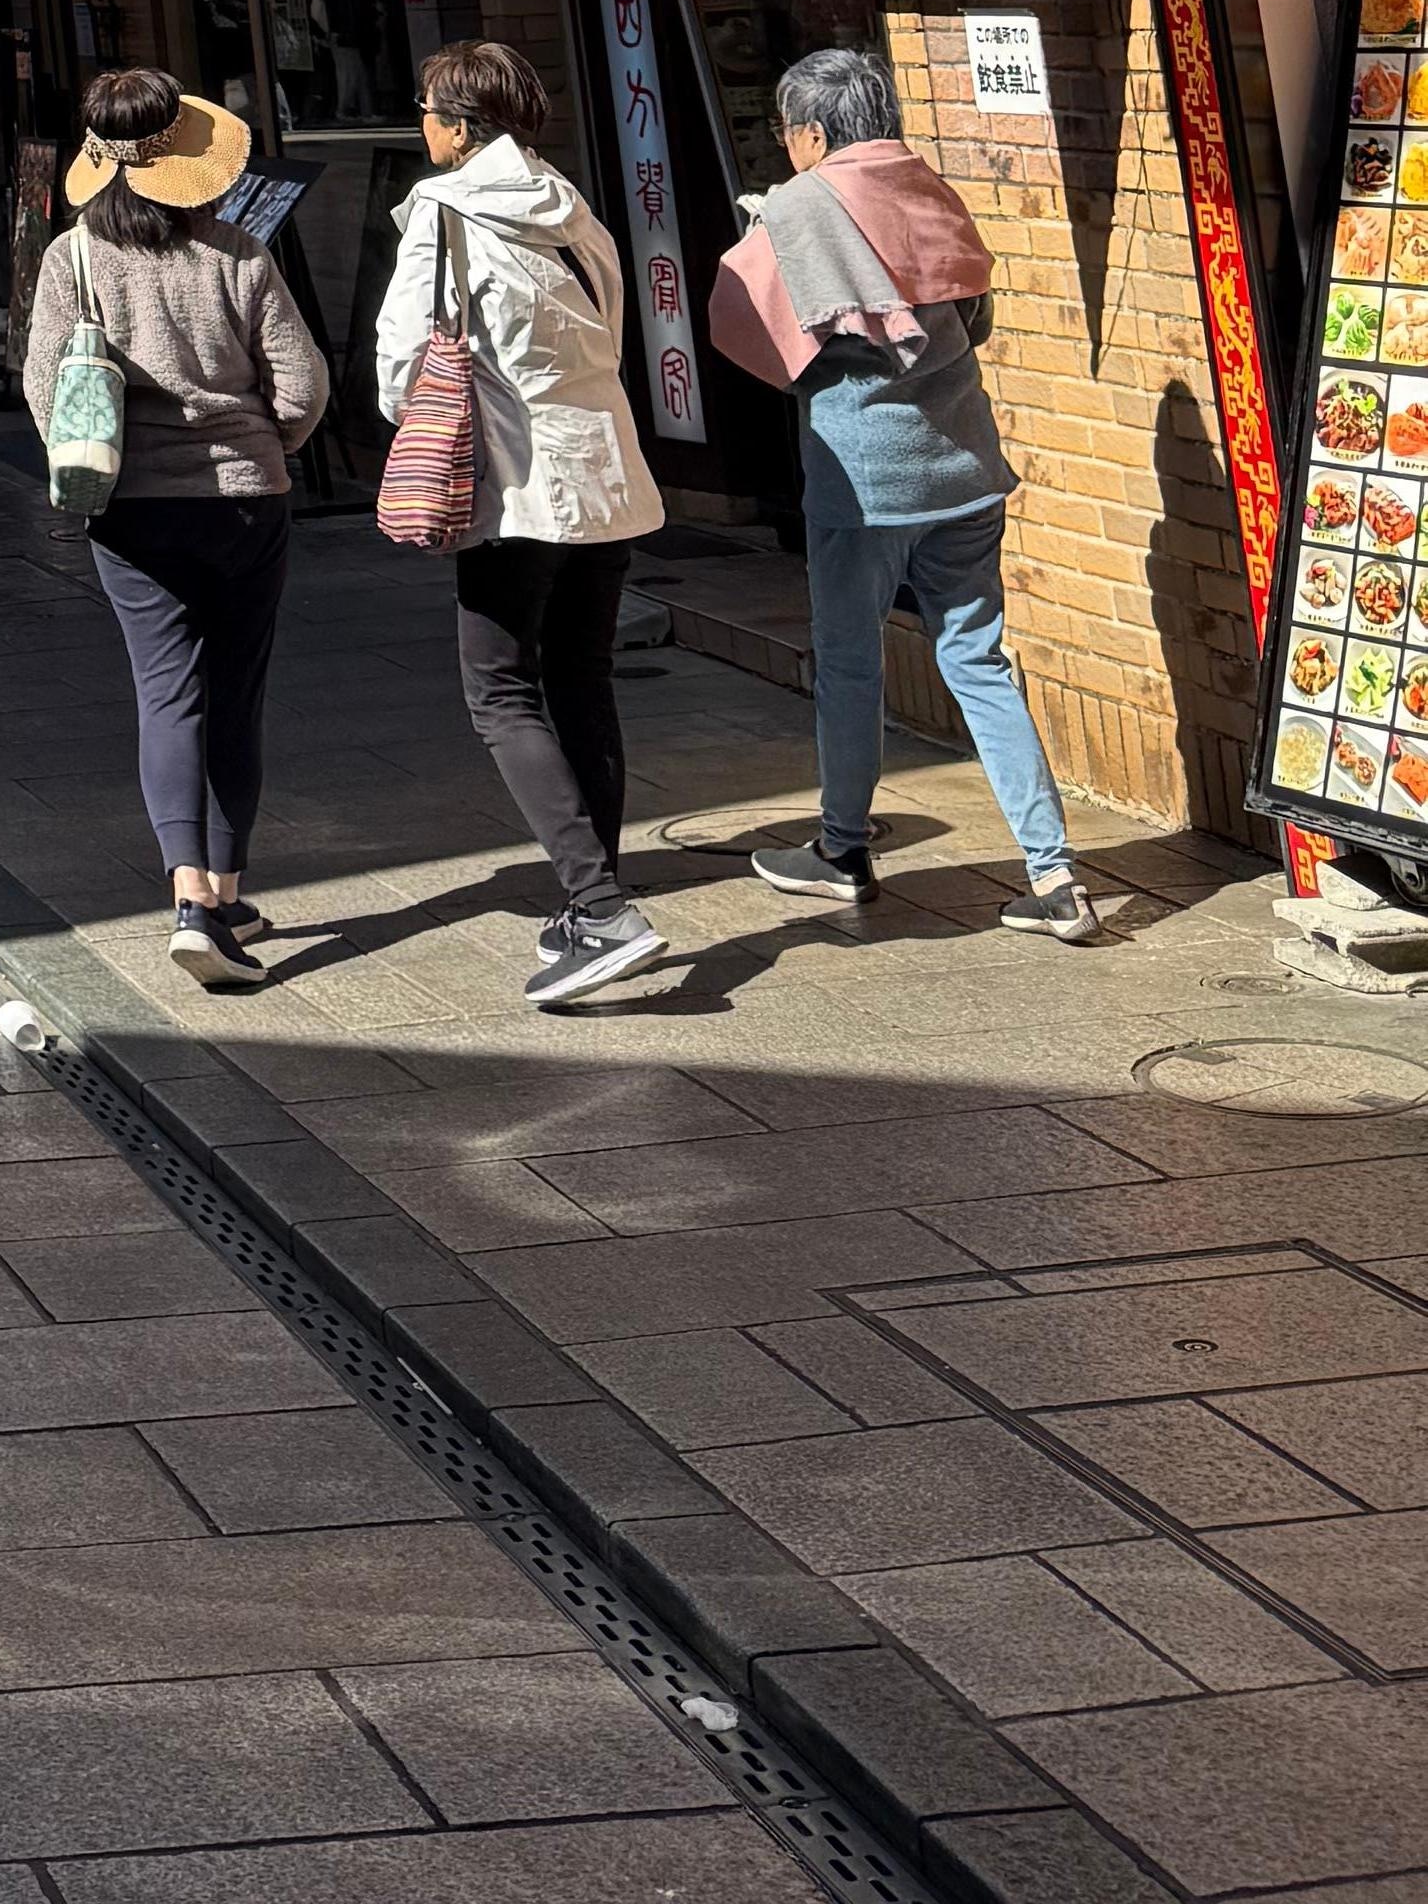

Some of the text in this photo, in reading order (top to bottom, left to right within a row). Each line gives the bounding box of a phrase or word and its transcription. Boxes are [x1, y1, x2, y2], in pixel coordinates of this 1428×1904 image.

[975, 25, 1030, 44] この場所での
[975, 61, 1042, 96] 飲食禁止
